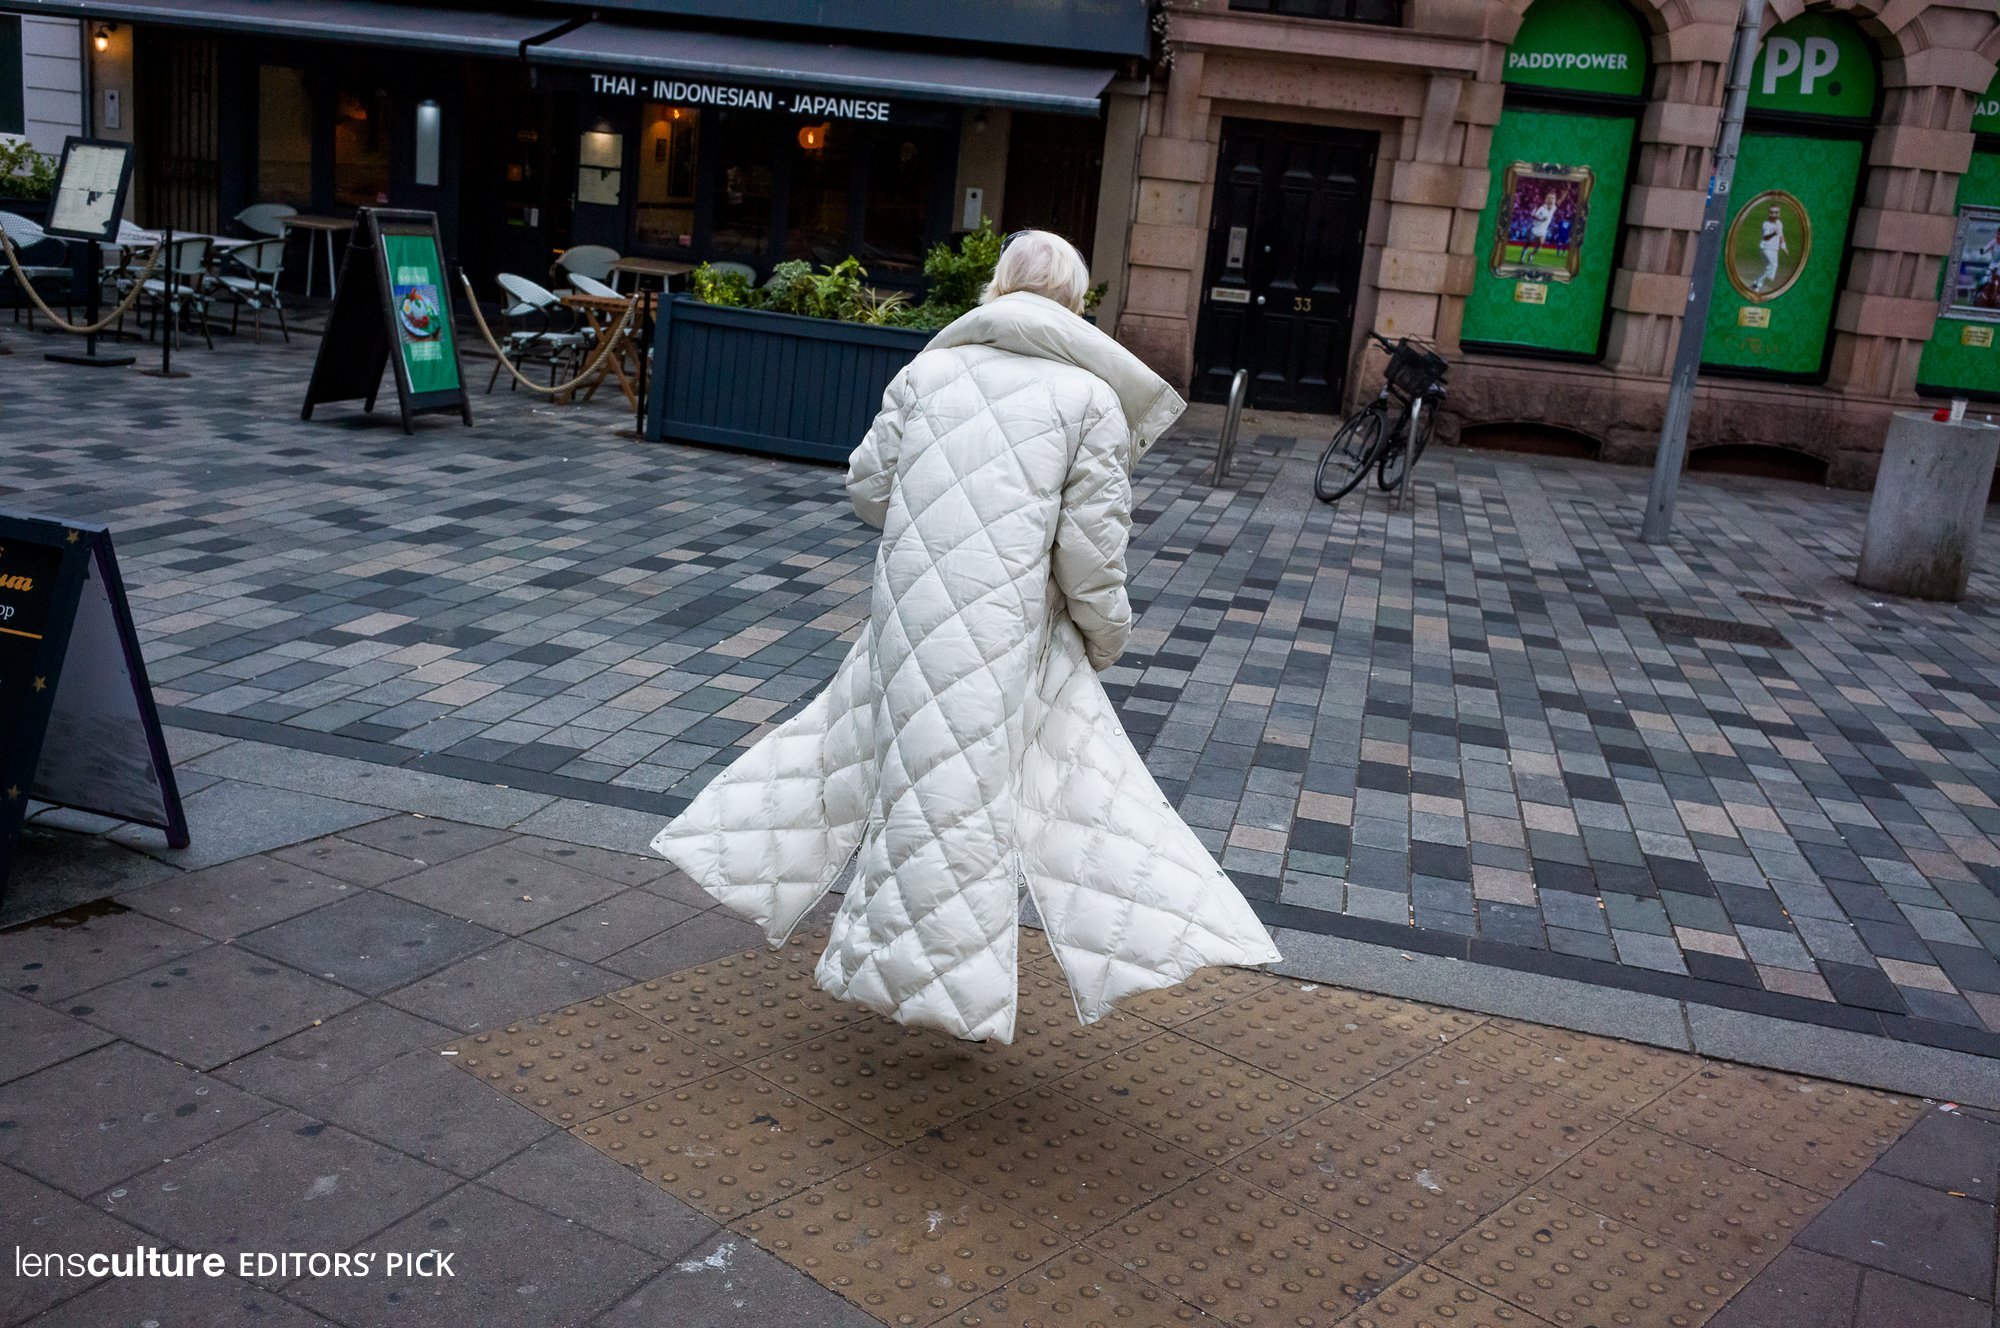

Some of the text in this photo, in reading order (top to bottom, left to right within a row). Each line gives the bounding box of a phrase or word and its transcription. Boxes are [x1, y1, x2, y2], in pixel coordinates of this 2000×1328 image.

[1508, 52, 1629, 70] PADDYPOWER
[591, 73, 635, 96] THAI
[653, 80, 773, 110] INDONESIAN
[789, 94, 890, 121] JAPANESE
[1718, 182, 1727, 192] 5
[1293, 296, 1312, 312] 33
